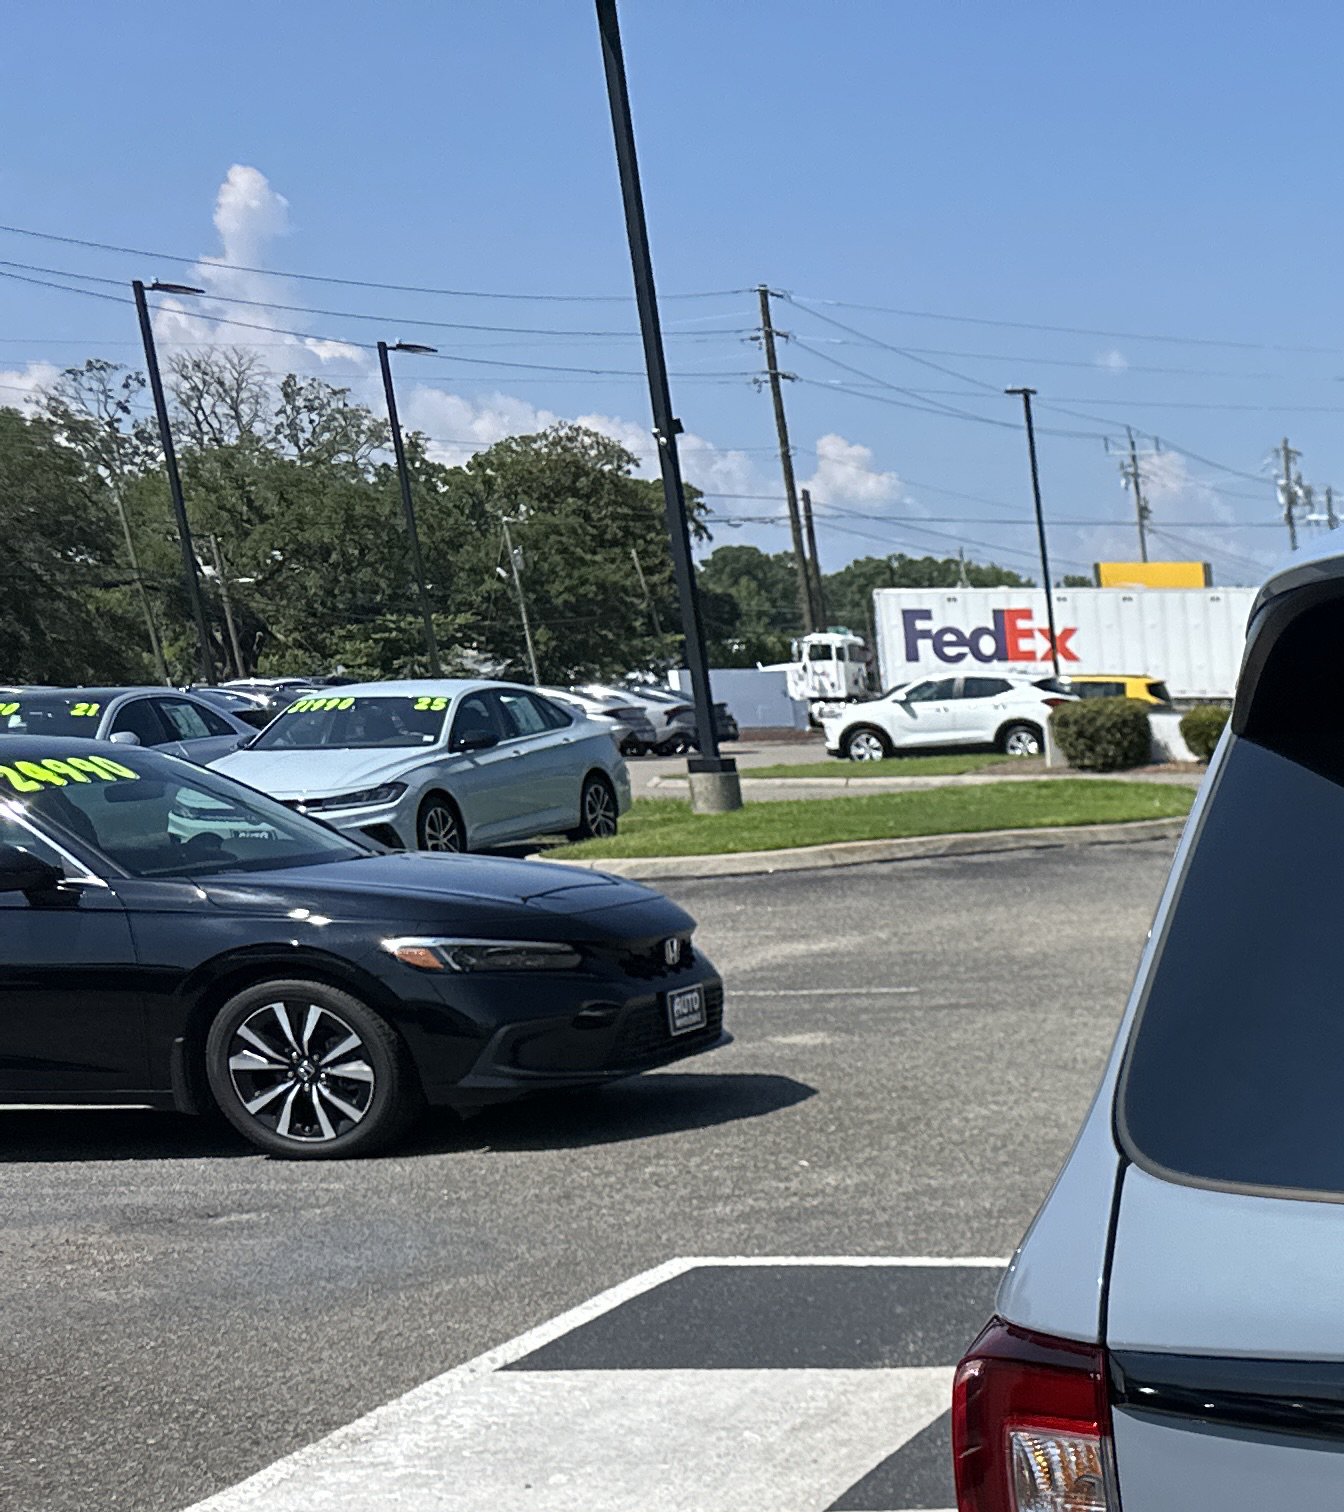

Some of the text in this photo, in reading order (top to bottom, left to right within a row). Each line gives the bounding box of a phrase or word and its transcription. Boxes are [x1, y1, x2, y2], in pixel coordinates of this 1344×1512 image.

[901, 608, 1081, 663] FedEx
[70, 702, 100, 717] 21
[413, 697, 448, 711] 25
